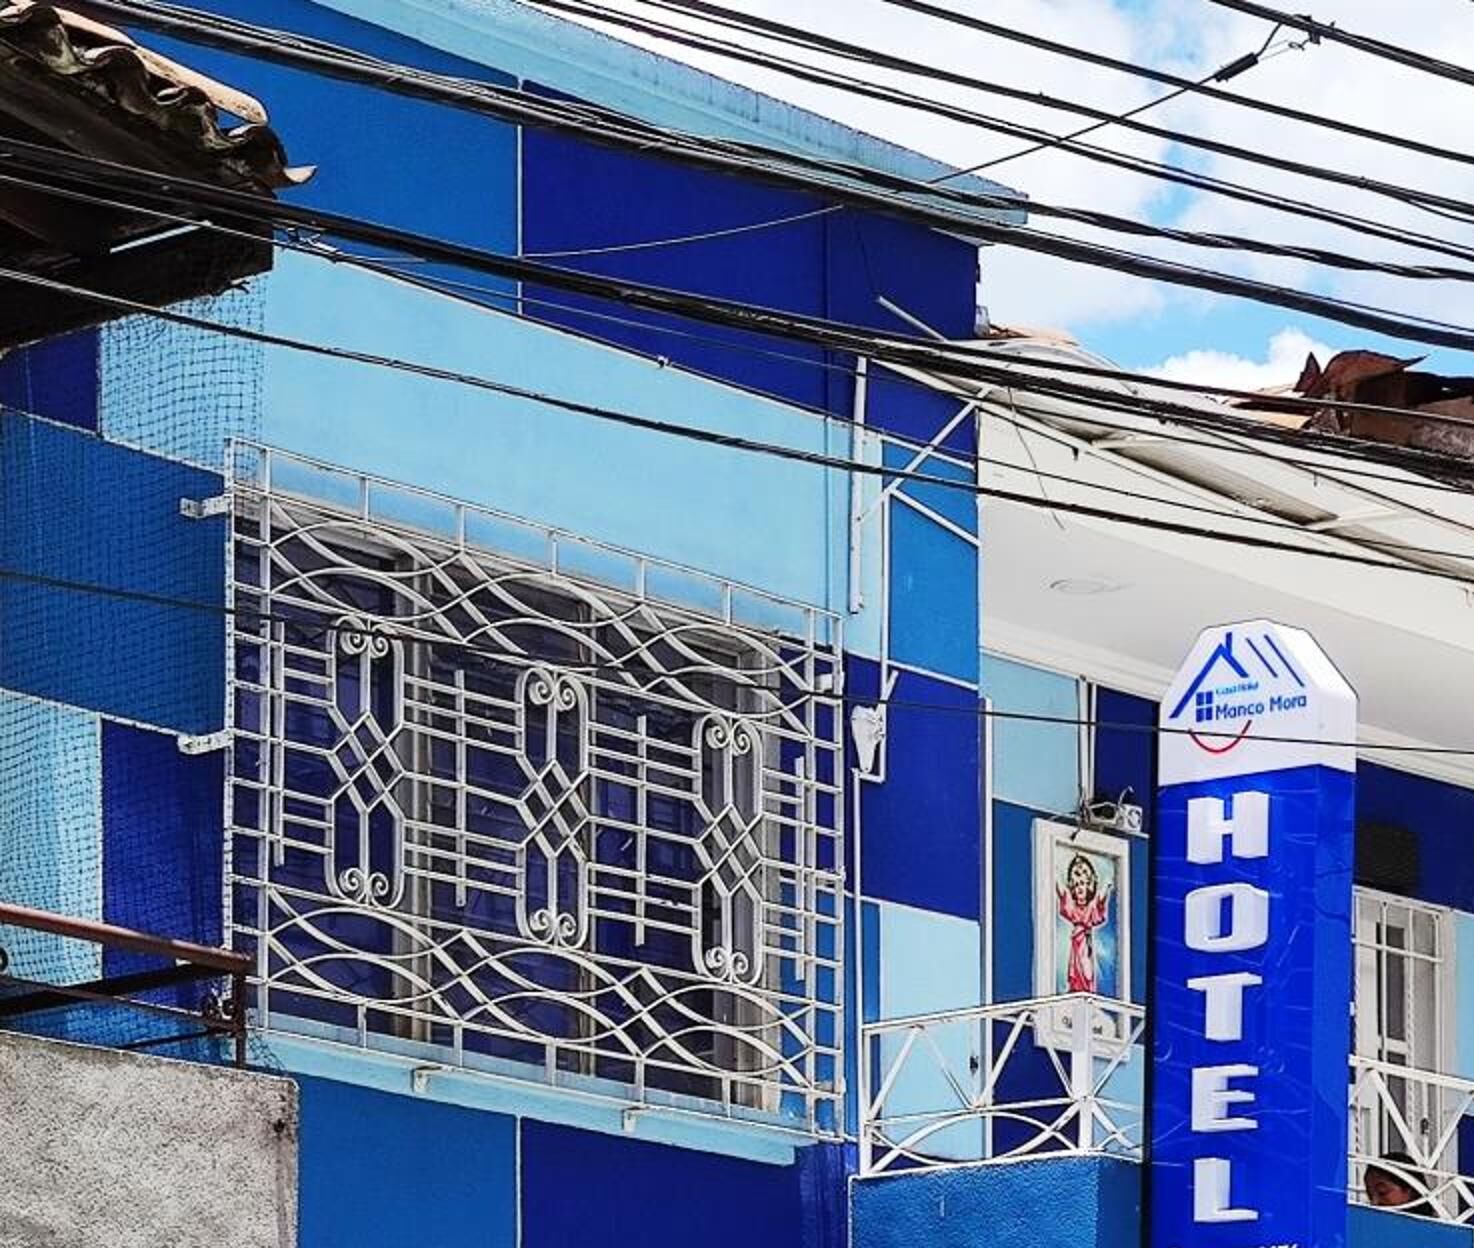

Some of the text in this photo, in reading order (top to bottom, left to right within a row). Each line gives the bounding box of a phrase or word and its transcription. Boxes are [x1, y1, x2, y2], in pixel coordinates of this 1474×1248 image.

[1215, 694, 1307, 720] Manco Mora
[1184, 789, 1270, 1223] HOTEL
